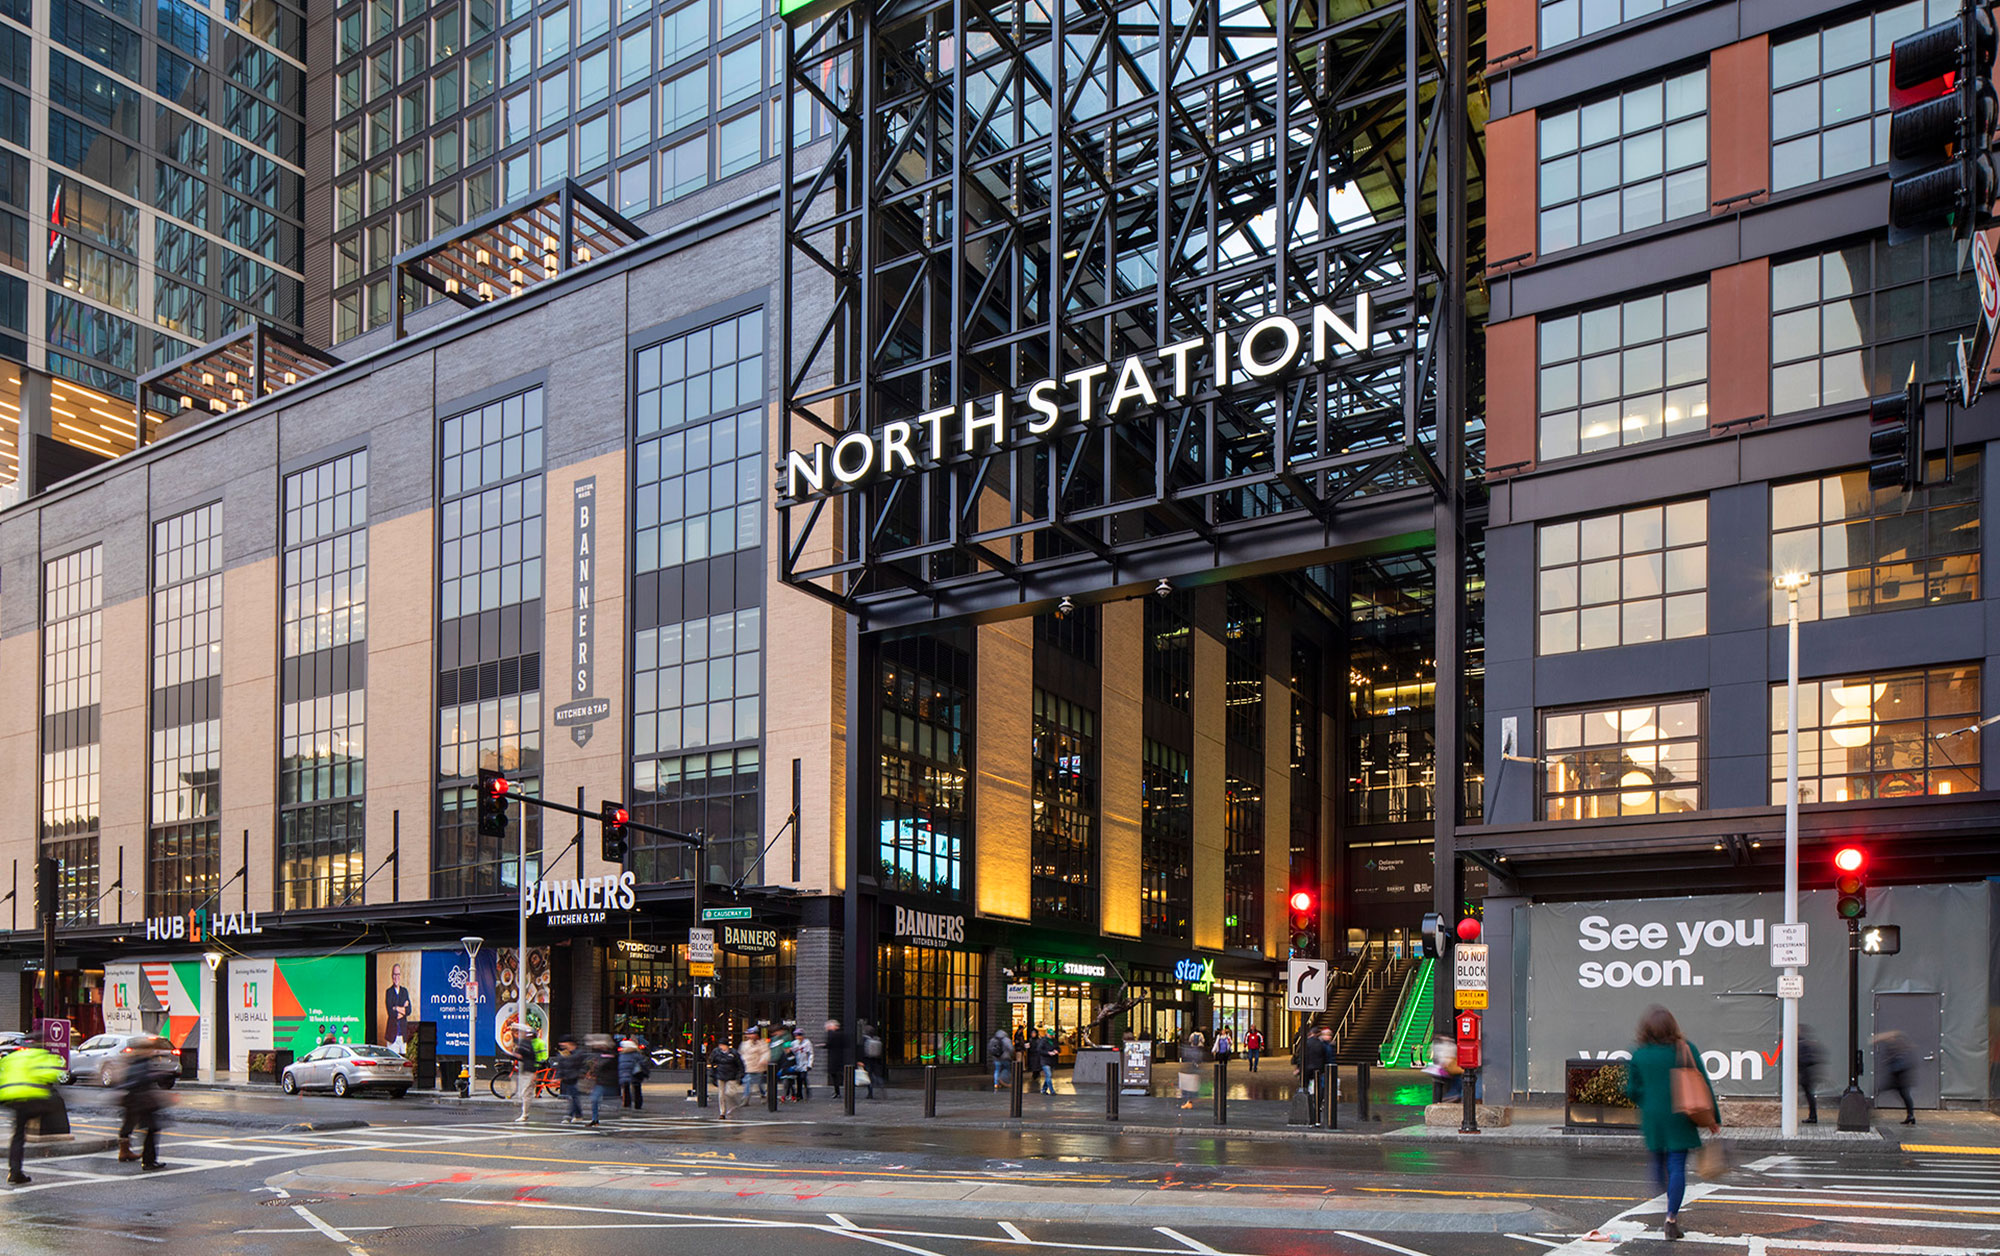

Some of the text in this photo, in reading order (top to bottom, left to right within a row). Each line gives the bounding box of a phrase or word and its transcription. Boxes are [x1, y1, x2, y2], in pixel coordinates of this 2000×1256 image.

[787, 292, 1370, 496] NORTH STATION
[578, 505, 589, 692] BANNERS
[556, 703, 608, 720] KITCHEN & TAP
[525, 871, 636, 916] BANNERS
[146, 909, 263, 941] HUB HALL
[547, 912, 606, 925] KITCHEN & TAP
[895, 905, 965, 943] BANNERS
[691, 932, 713, 941] DO NOT
[724, 926, 777, 948] BANNERS
[913, 937, 934, 946] KITCHEN
[938, 940, 948, 948] TAP
[1578, 915, 1765, 956] See you
[625, 942, 667, 953] TOPGOLF
[691, 943, 713, 951] BLOCK
[1457, 951, 1486, 962] DO NOT
[1063, 962, 1105, 977] STARBUCKS
[1175, 958, 1204, 981] star
[1457, 966, 1486, 976] BLOCK
[1578, 959, 1704, 988] soon.
[625, 973, 669, 989] ANNRS
[1458, 979, 1487, 987] INTERSECTION
[1293, 996, 1321, 1006] ONLY
[107, 1012, 137, 1020] HUB HALL
[234, 1012, 268, 1021] HUB HALL
